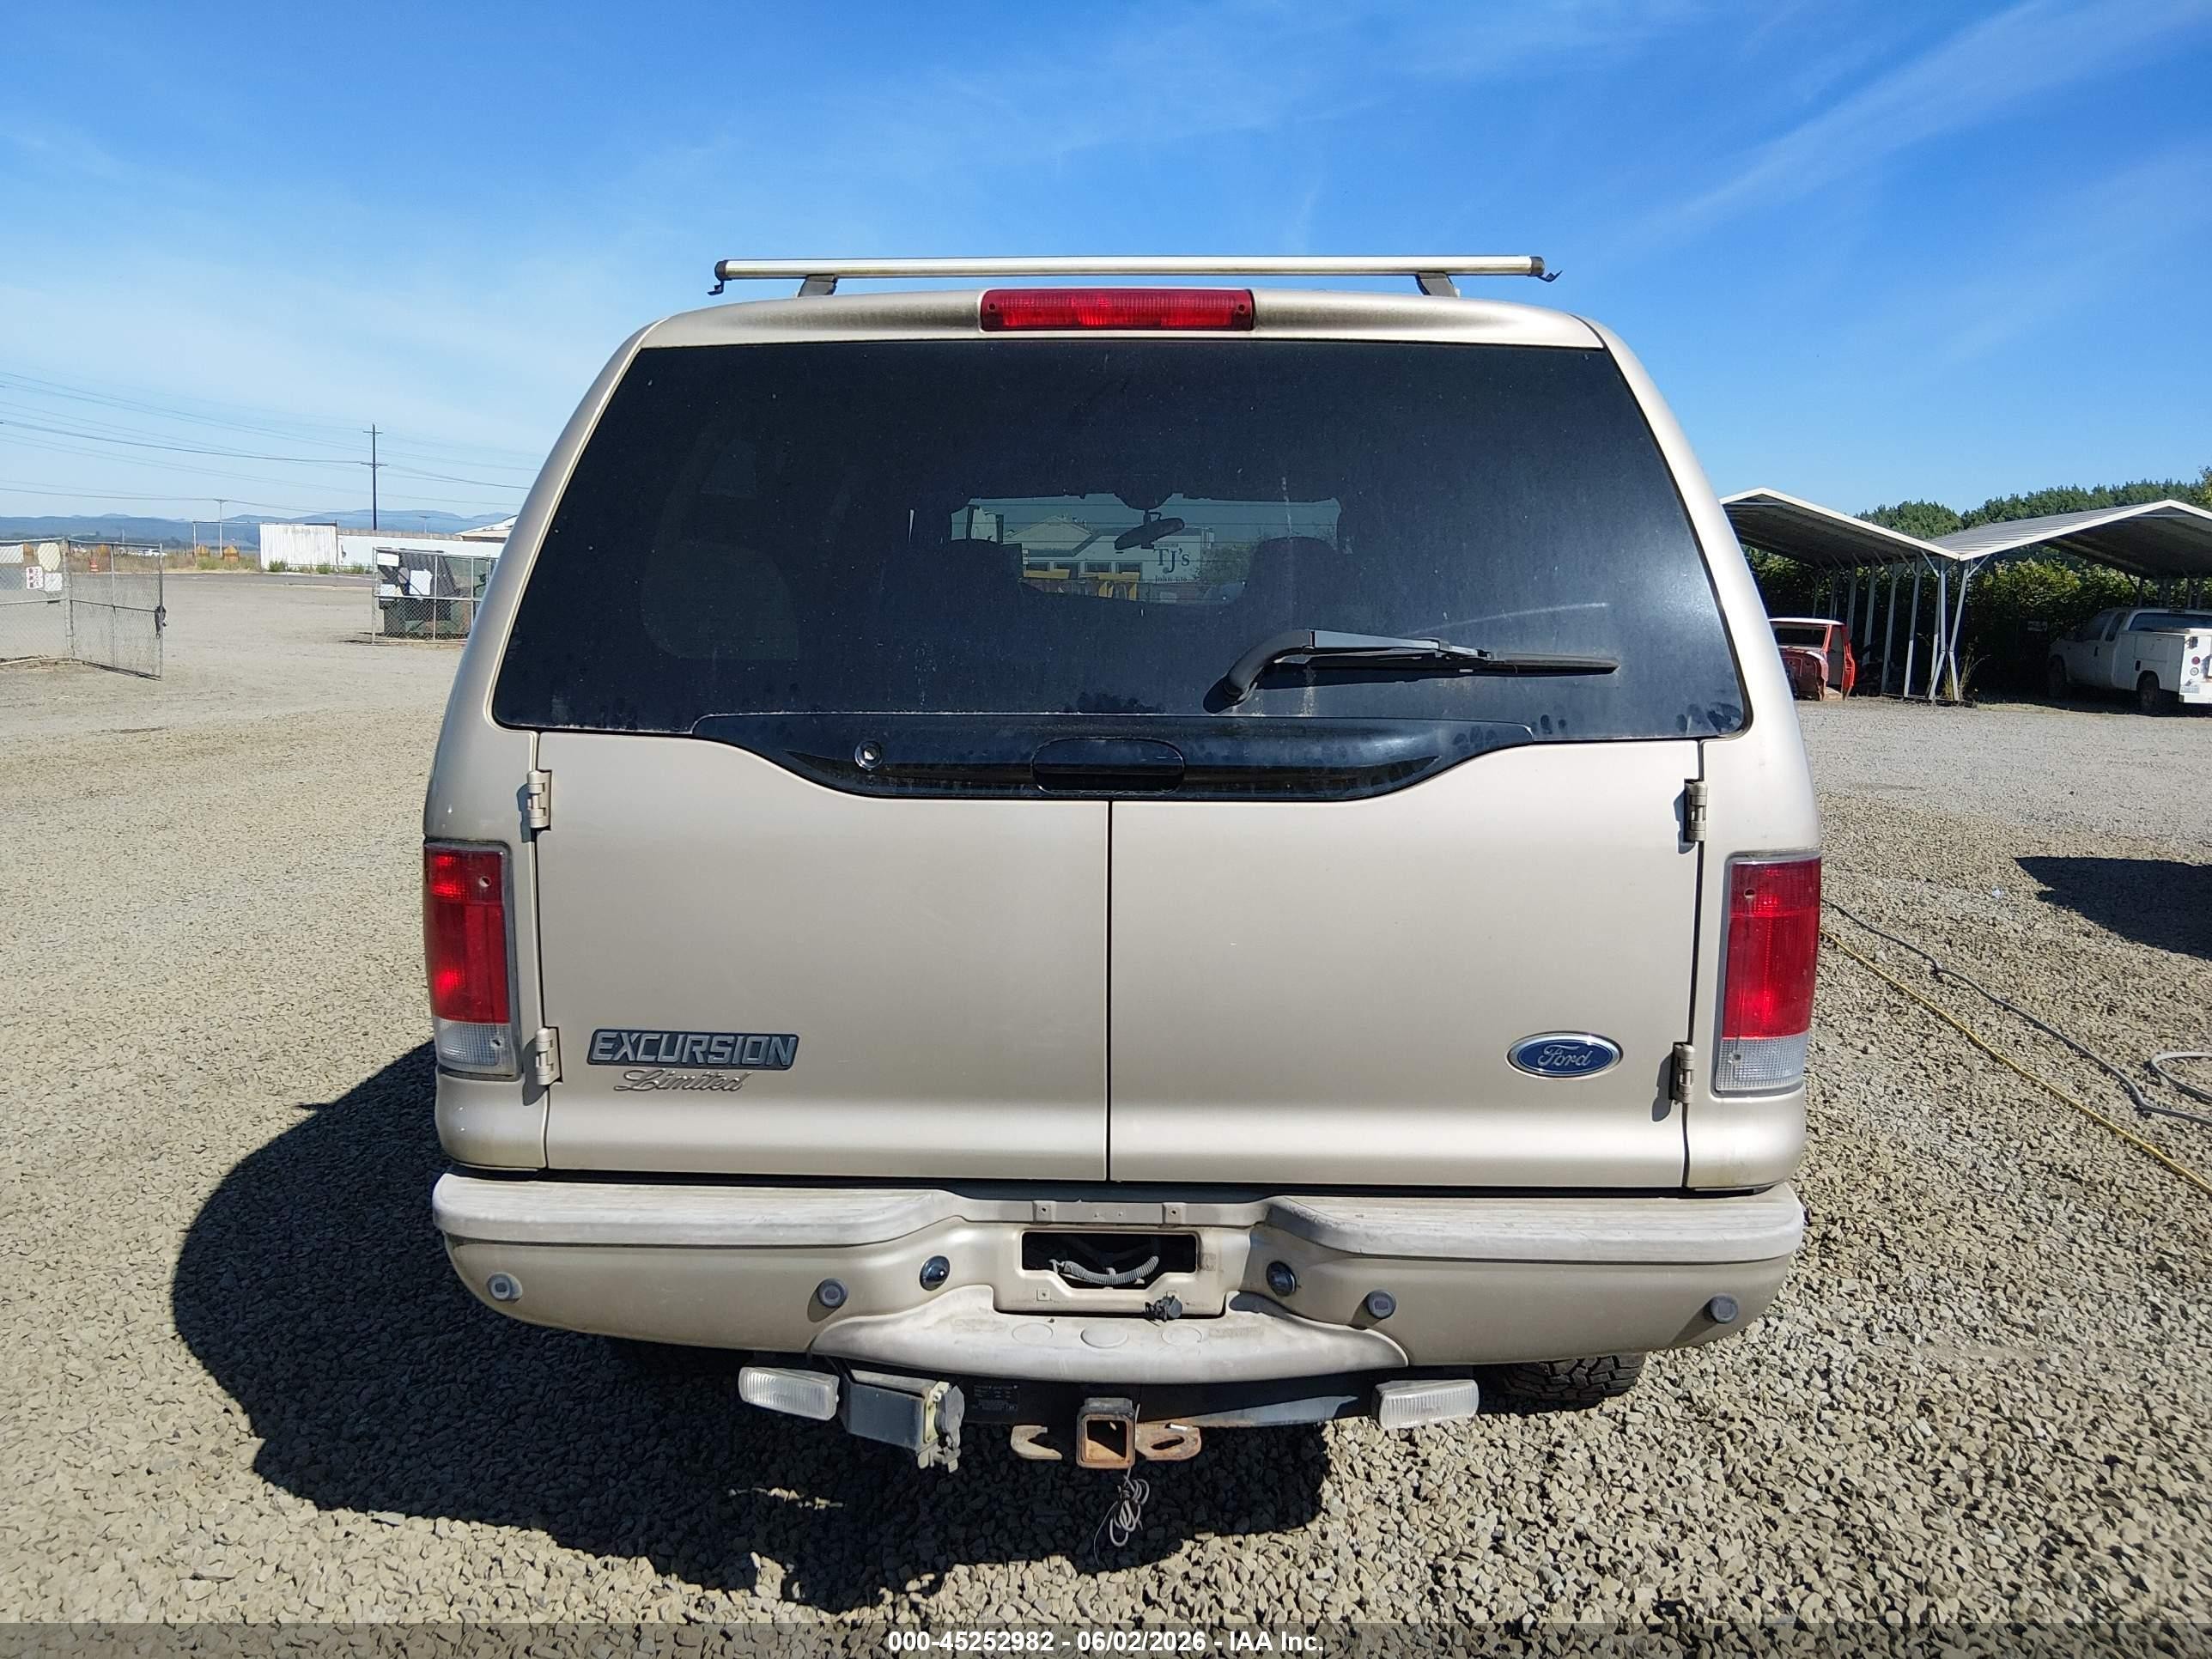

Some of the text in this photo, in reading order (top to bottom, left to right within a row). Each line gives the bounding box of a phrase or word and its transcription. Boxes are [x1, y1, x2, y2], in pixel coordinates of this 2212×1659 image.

[1152, 547, 1190, 574] TJ's
[591, 1030, 797, 1066] EXCURSION
[1537, 1044, 1593, 1066] Ford
[613, 1068, 753, 1092] Limited
